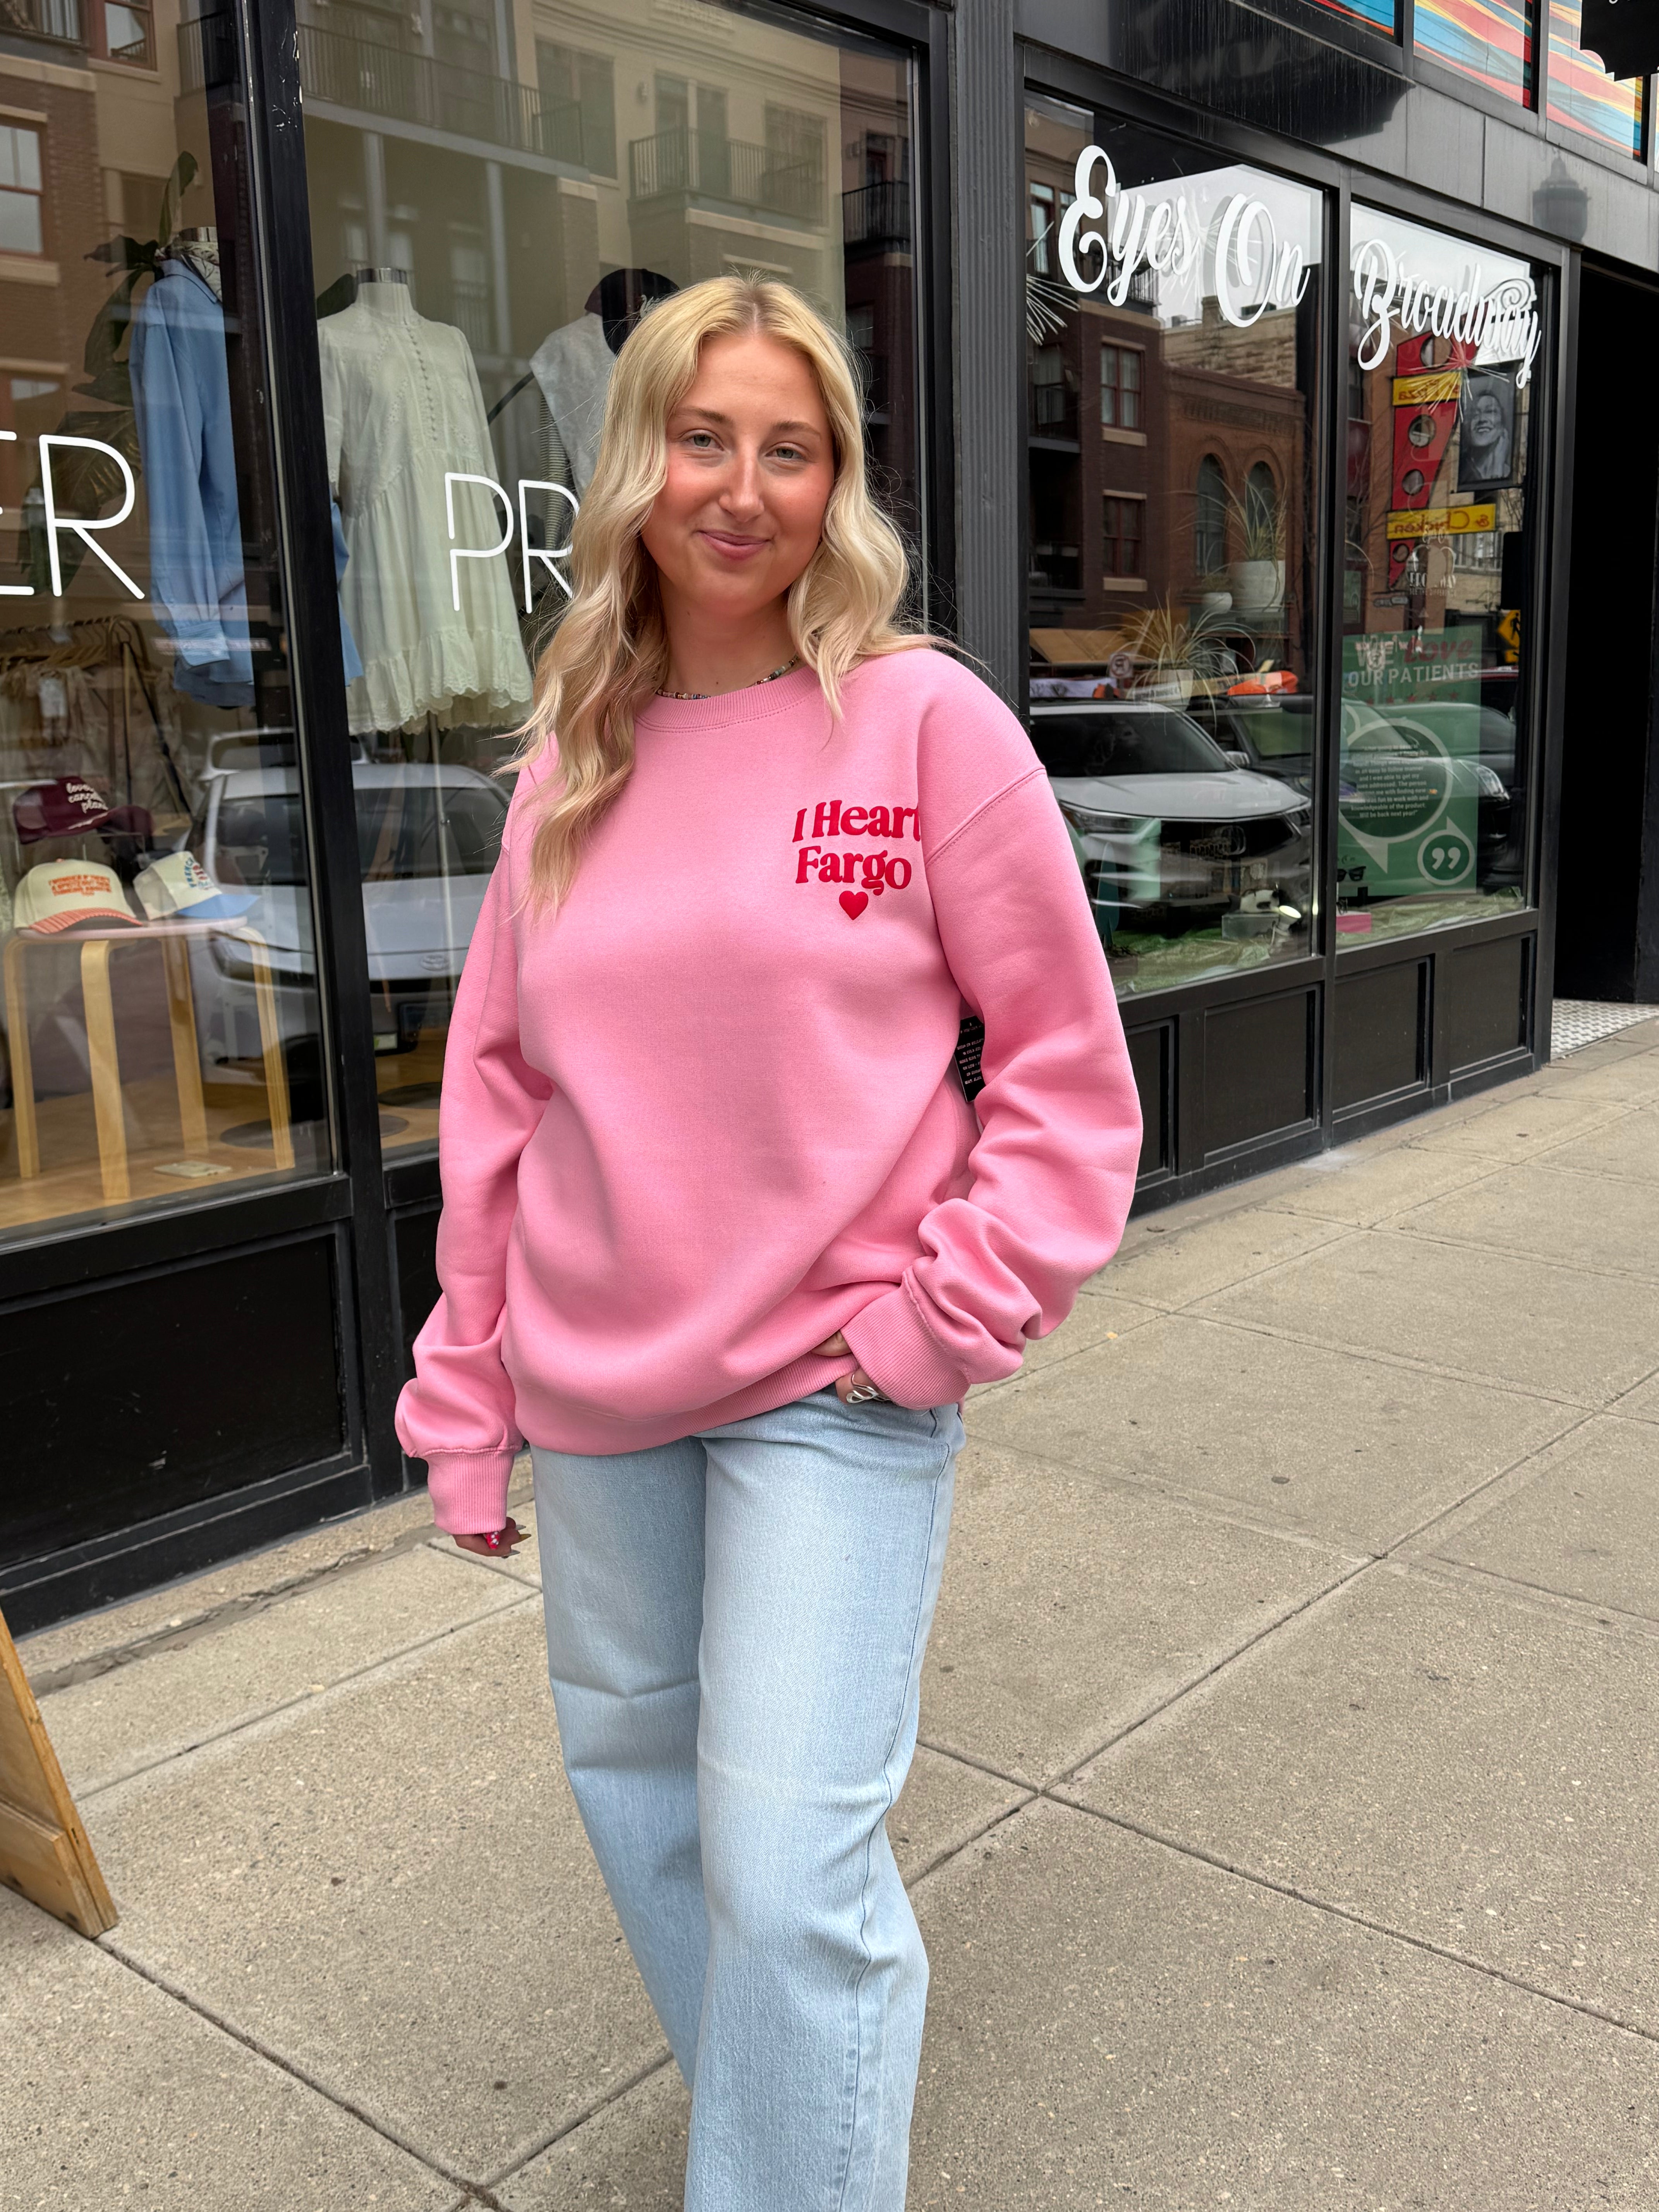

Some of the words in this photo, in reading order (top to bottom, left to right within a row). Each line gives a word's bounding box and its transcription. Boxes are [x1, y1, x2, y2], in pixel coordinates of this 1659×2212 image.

[1059, 146, 1197, 306] Eyes
[1215, 193, 1310, 327] On
[1353, 239, 1541, 389] Broadway
[1404, 635, 1473, 663] Love
[1348, 670, 1383, 687] OUR
[1388, 662, 1479, 685] PATIENTS
[792, 809, 807, 843] I
[812, 800, 921, 842] Heart
[795, 846, 912, 896] Fargo
